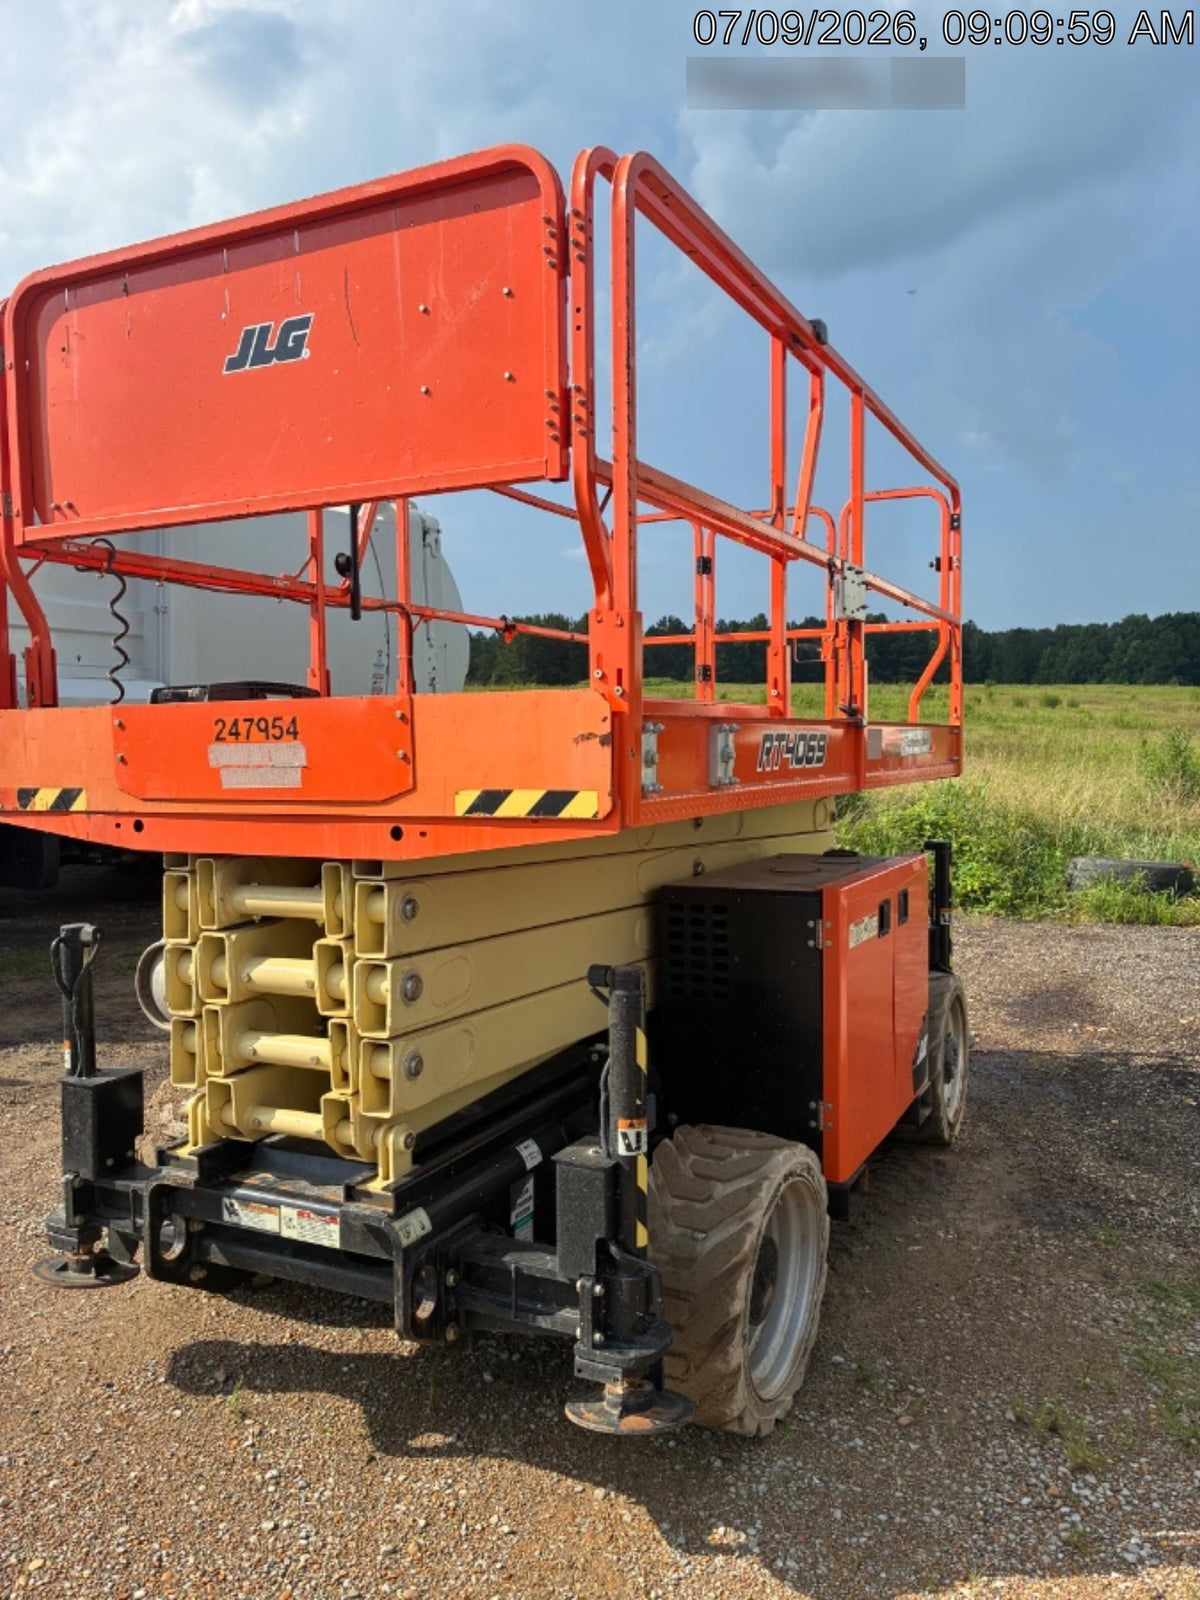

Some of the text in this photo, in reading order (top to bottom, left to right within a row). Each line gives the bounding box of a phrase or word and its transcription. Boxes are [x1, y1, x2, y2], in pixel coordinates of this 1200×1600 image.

[222, 313, 315, 375] JLG
[214, 716, 299, 742] 247954
[756, 730, 828, 772] RT4069
